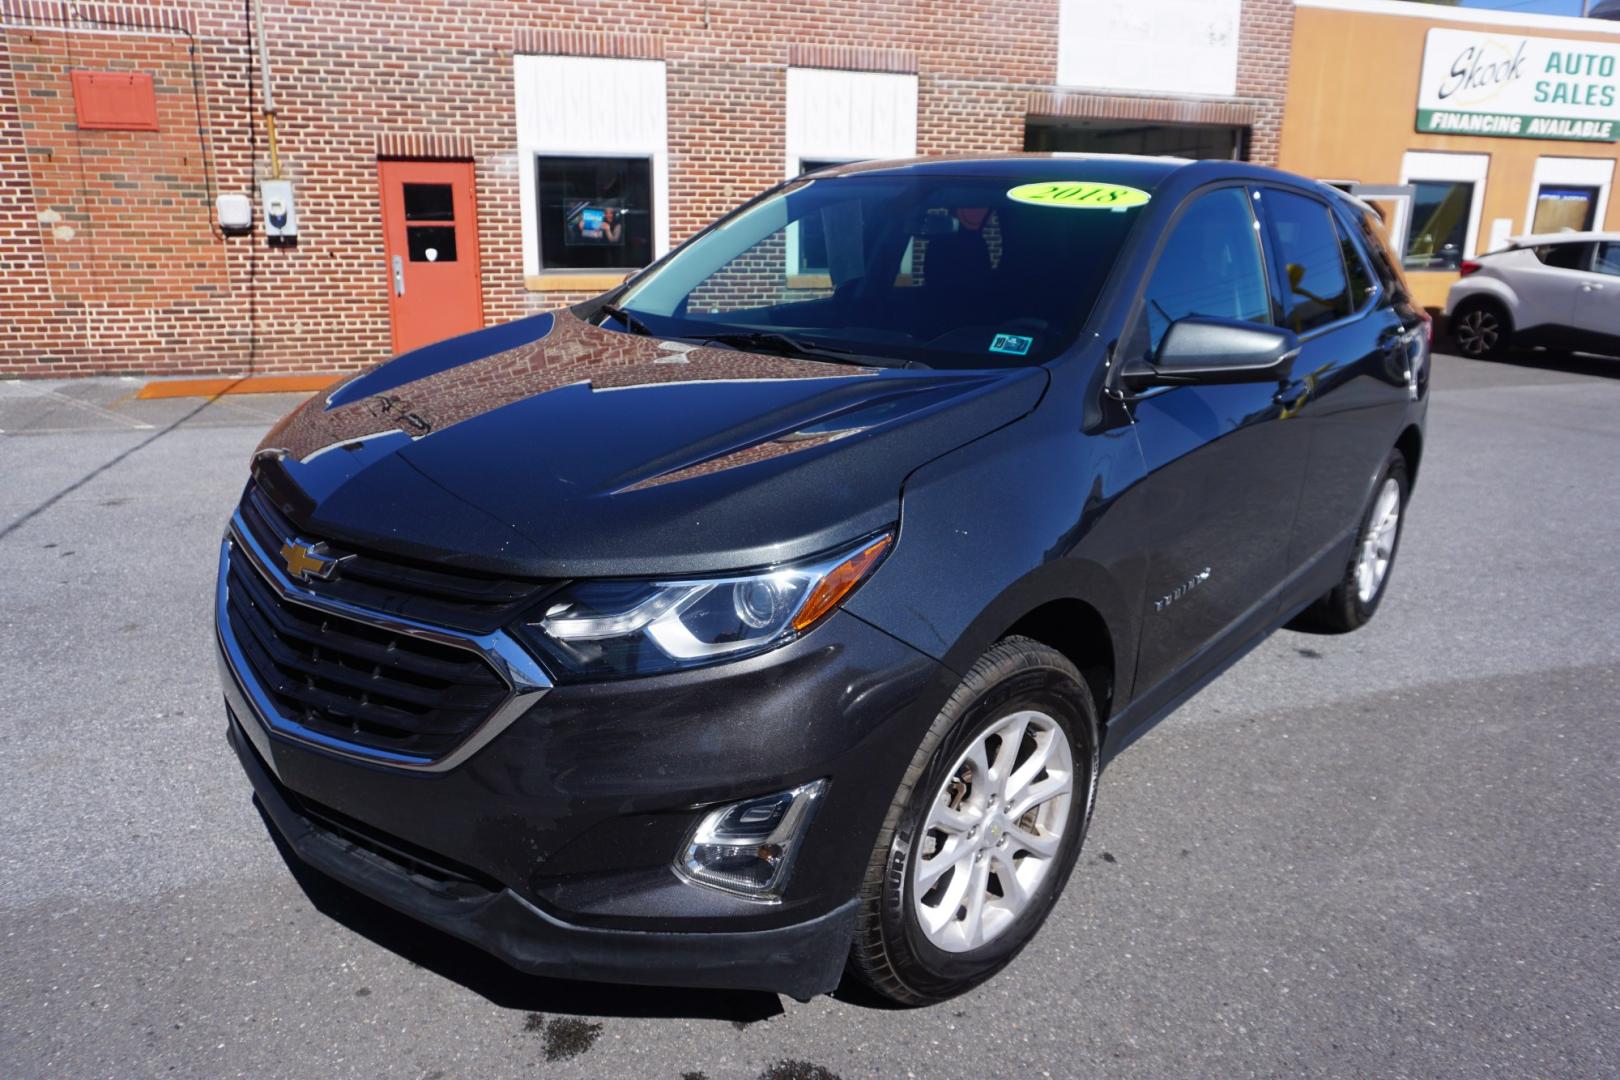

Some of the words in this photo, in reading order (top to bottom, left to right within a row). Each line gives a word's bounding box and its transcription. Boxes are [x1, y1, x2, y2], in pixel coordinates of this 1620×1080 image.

[1438, 39, 1527, 99] Skook
[1545, 52, 1616, 77] AUTO
[1534, 81, 1616, 107] SALES
[1429, 111, 1521, 133] FINANCING
[1526, 117, 1613, 138] AVAILABLE
[1027, 185, 1129, 202] 2018
